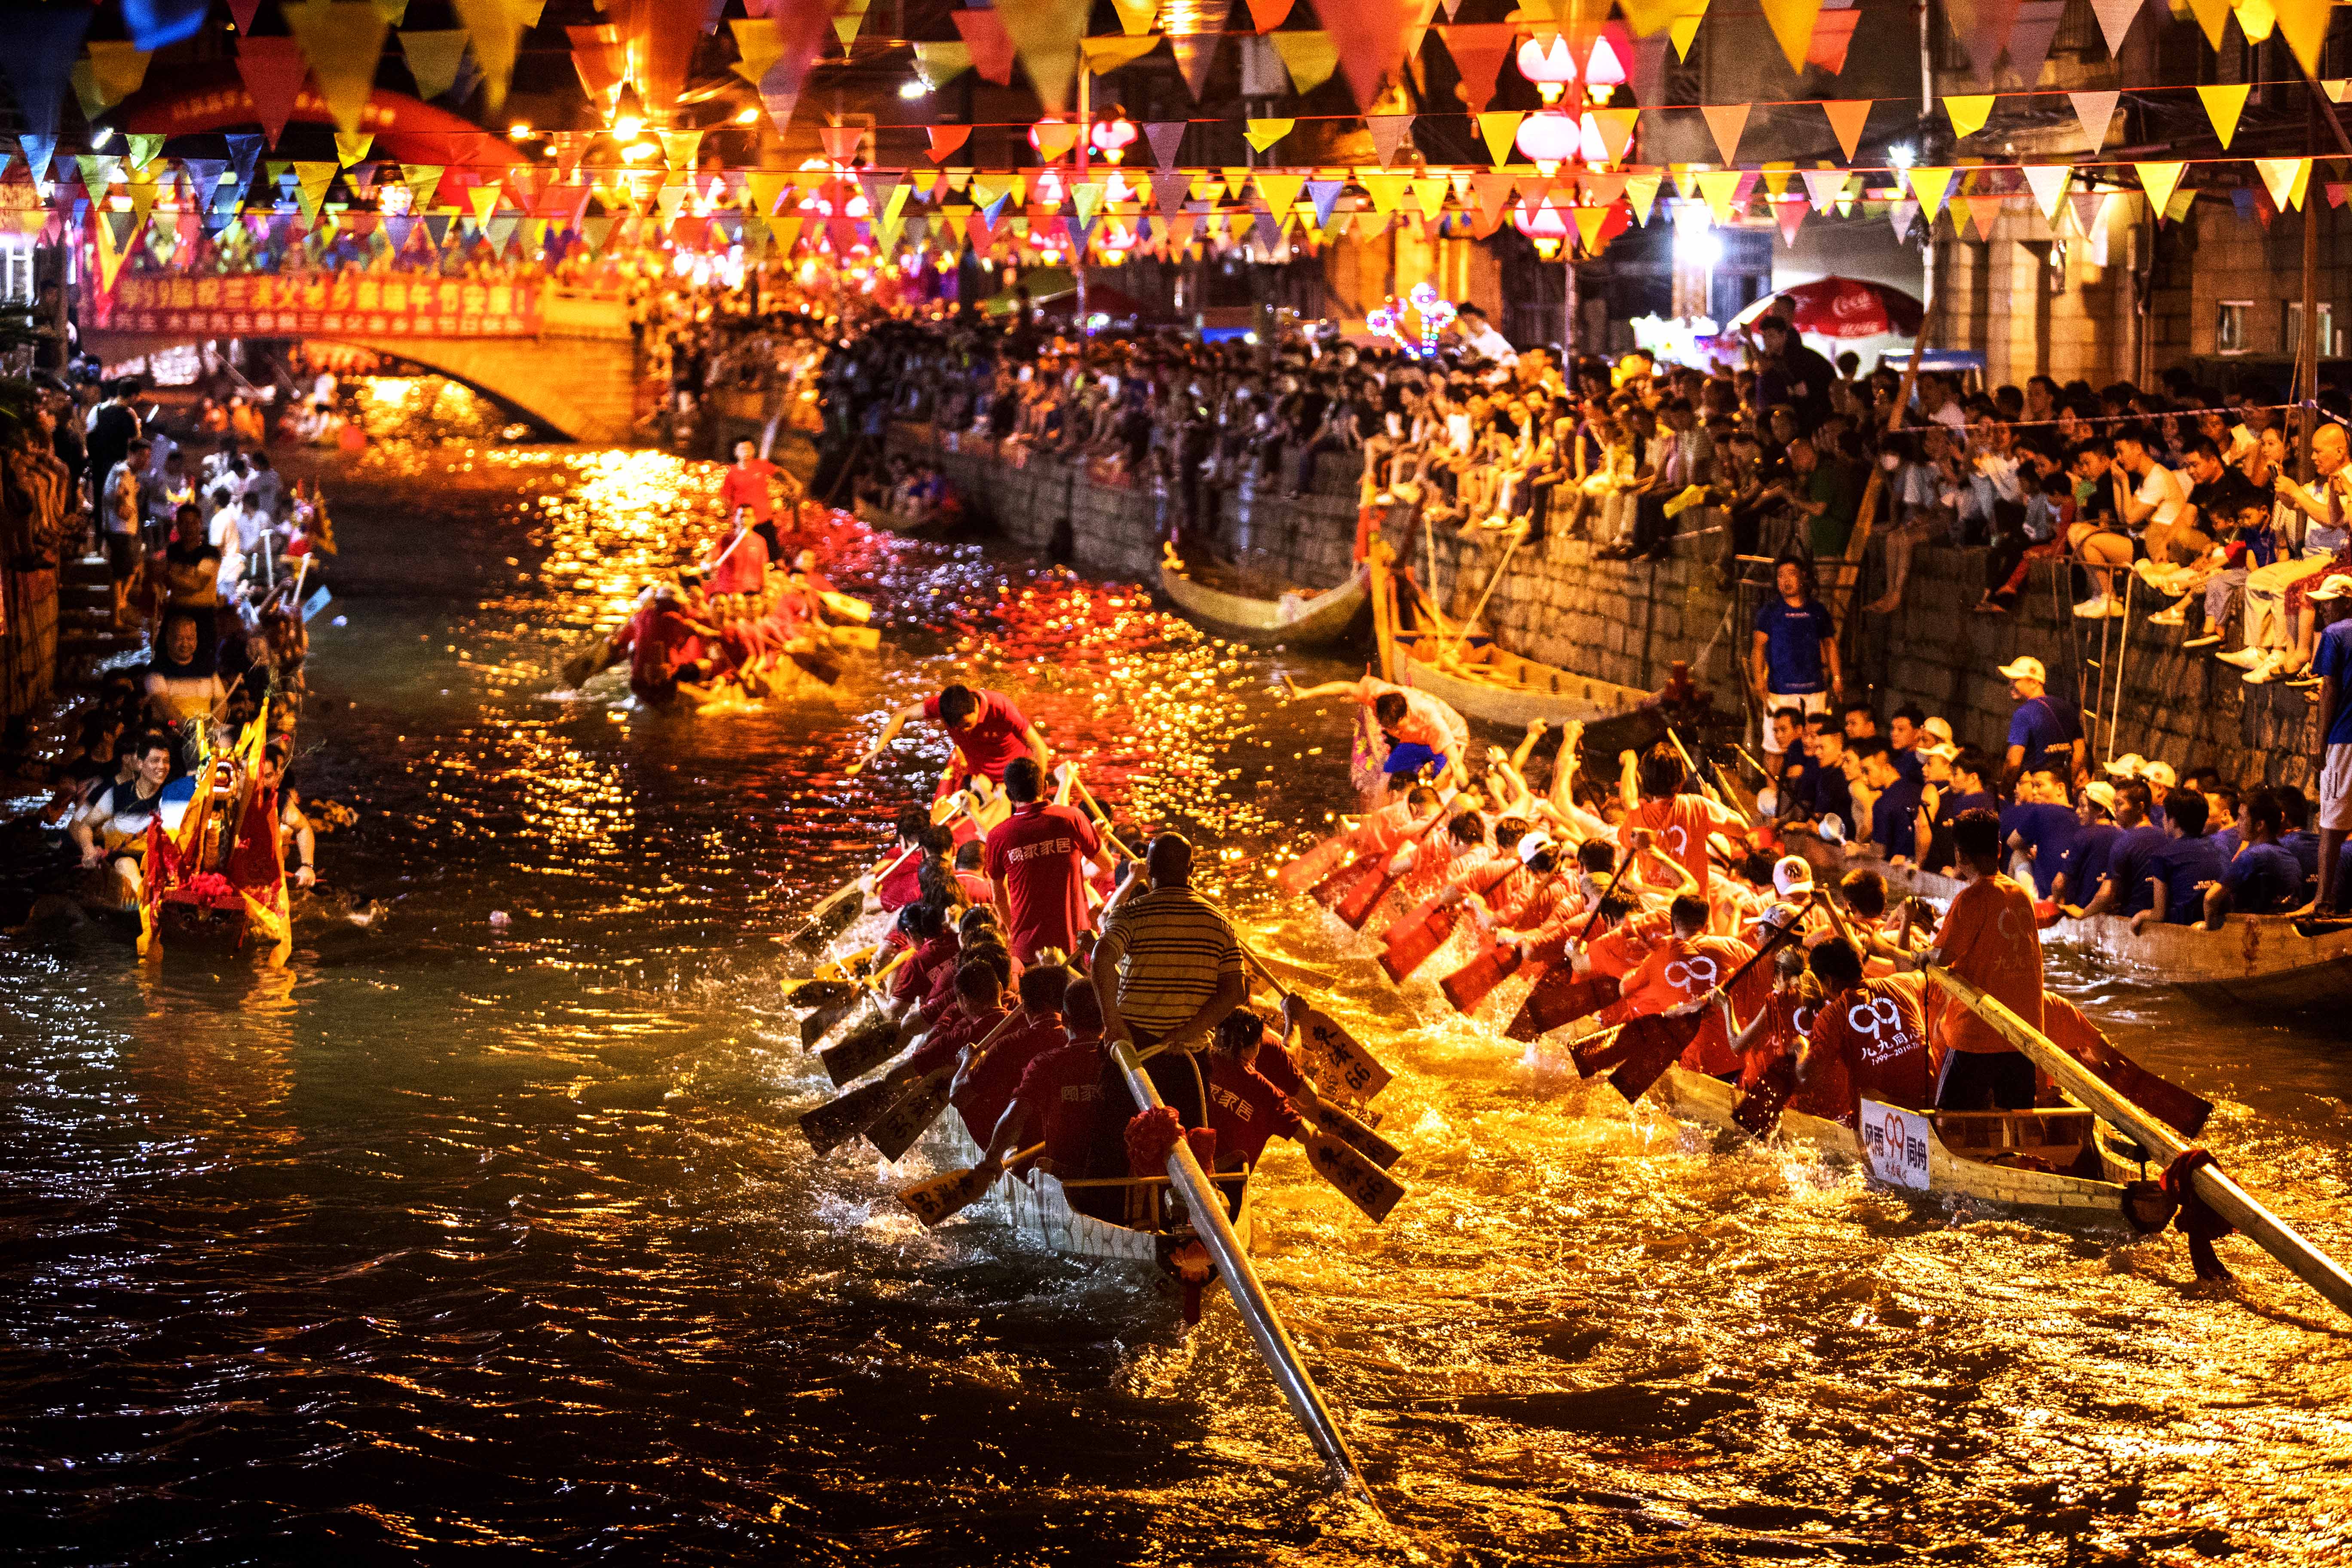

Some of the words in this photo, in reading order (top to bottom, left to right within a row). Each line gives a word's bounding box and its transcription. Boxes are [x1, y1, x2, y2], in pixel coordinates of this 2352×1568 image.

[1665, 956, 1717, 993] 99
[1849, 997, 1902, 1040] 99
[1344, 1062, 1371, 1090] 66
[1210, 1082, 1254, 1122] 家家居
[1865, 1122, 1884, 1157] 风雨
[1885, 1112, 1905, 1161] 99
[1907, 1135, 1927, 1171] 同舟
[1357, 1176, 1385, 1204] 66
